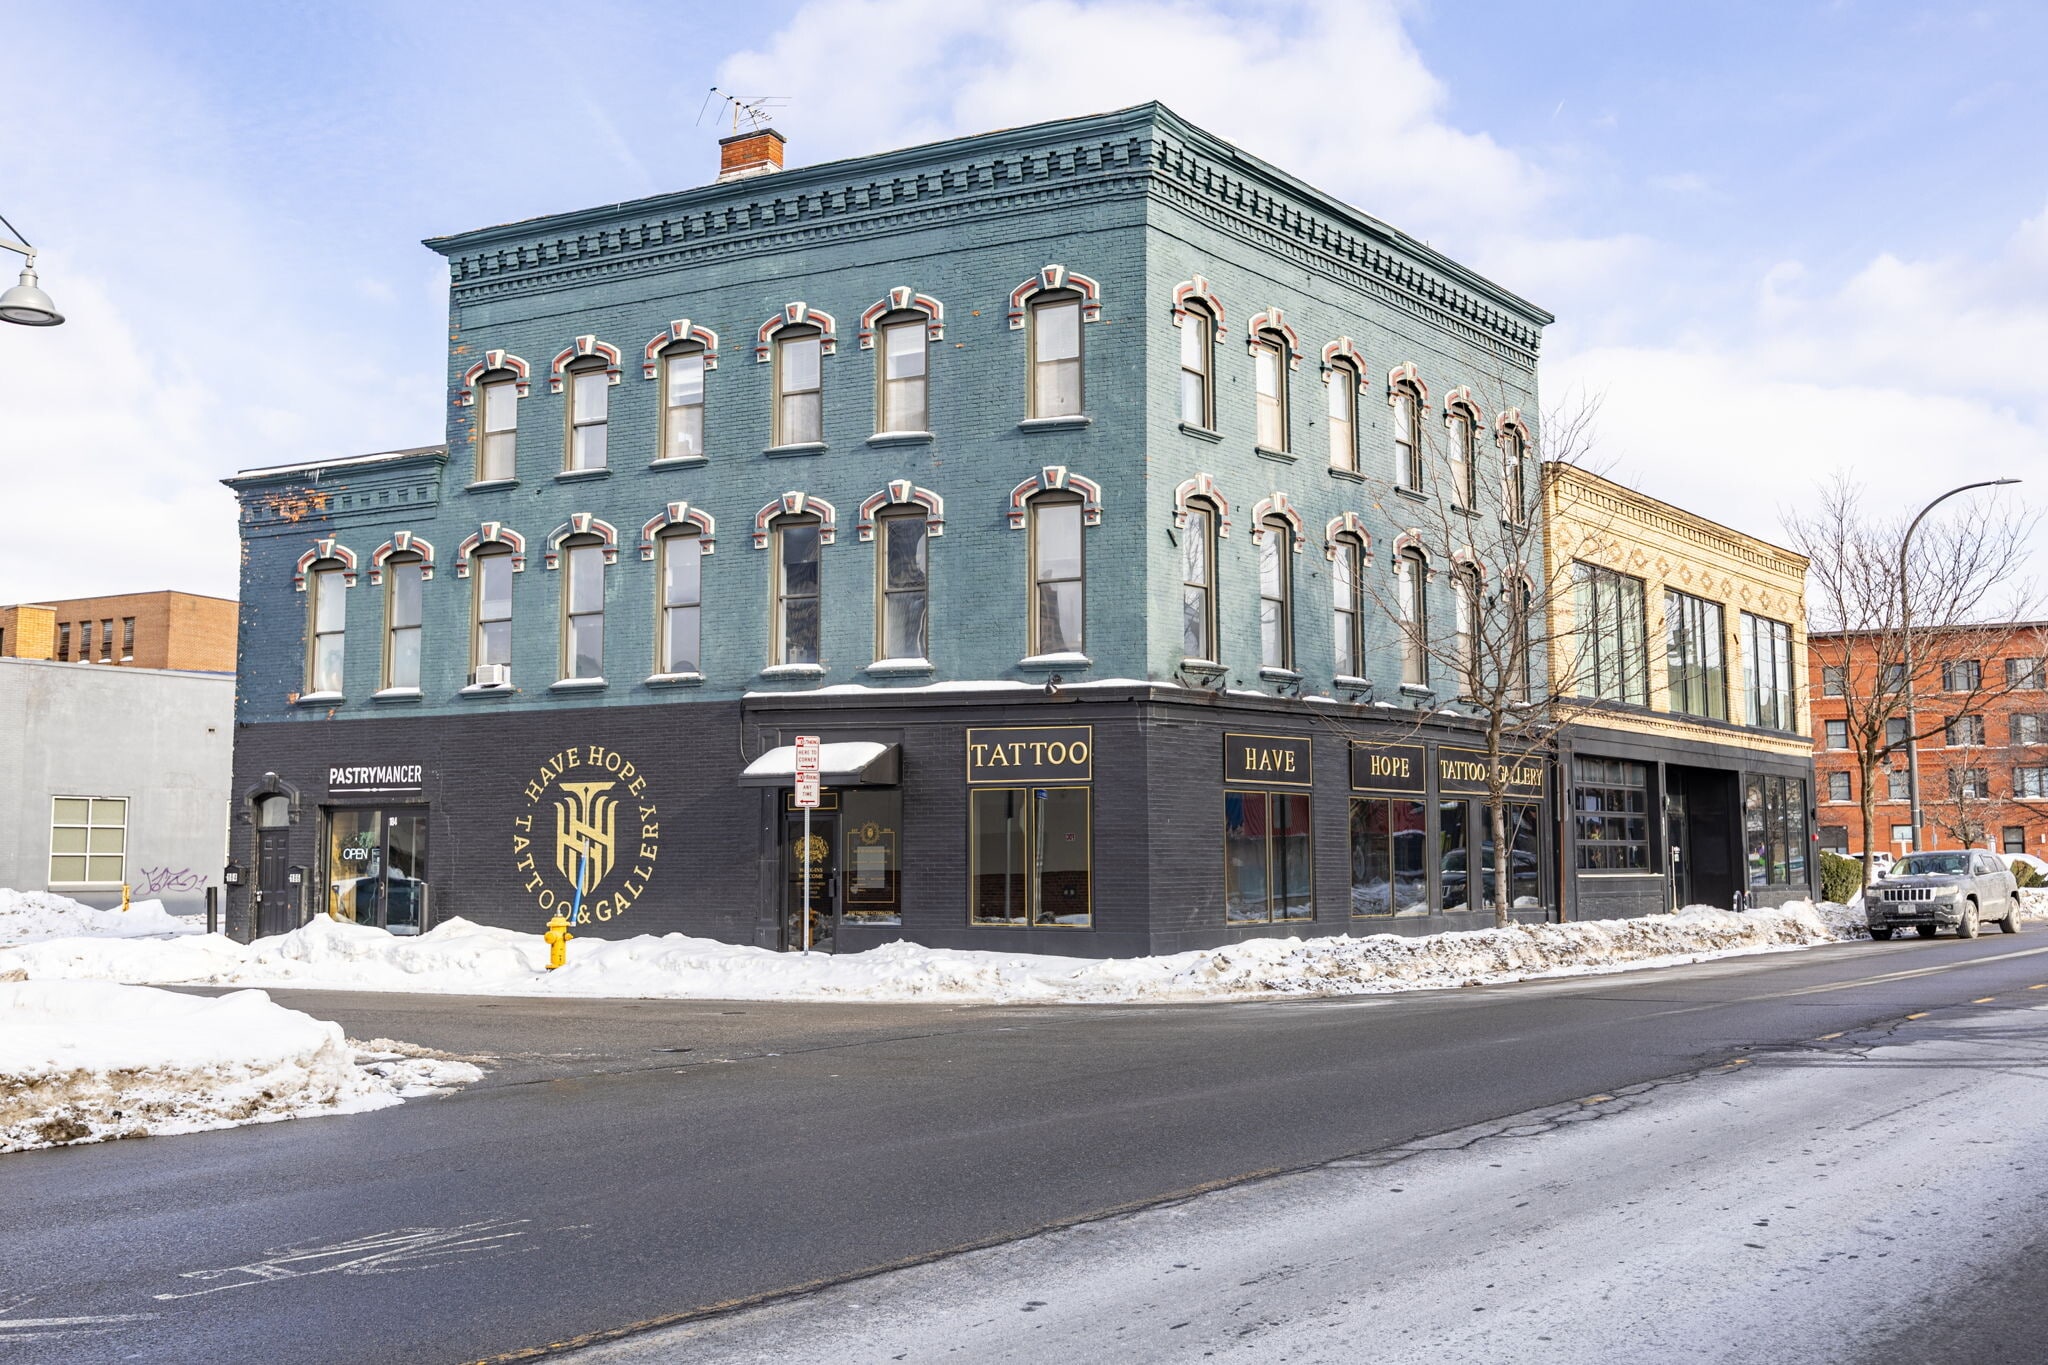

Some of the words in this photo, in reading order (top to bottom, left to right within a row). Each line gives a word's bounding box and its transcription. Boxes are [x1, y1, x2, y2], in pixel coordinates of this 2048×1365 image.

[970, 741, 1088, 767] TATTOO
[1244, 747, 1296, 772] HAVE
[1370, 754, 1410, 778] HOPE
[329, 765, 422, 785] PASTRYMANCER
[525, 747, 580, 803] HAVE
[587, 745, 647, 797] HOPE
[1440, 759, 1486, 782] TATTOO
[1497, 764, 1543, 786] GALLERY
[389, 816, 398, 826] 184
[343, 848, 368, 860] OPEN
[576, 903, 591, 925] &
[595, 804, 660, 922] GALLERY
